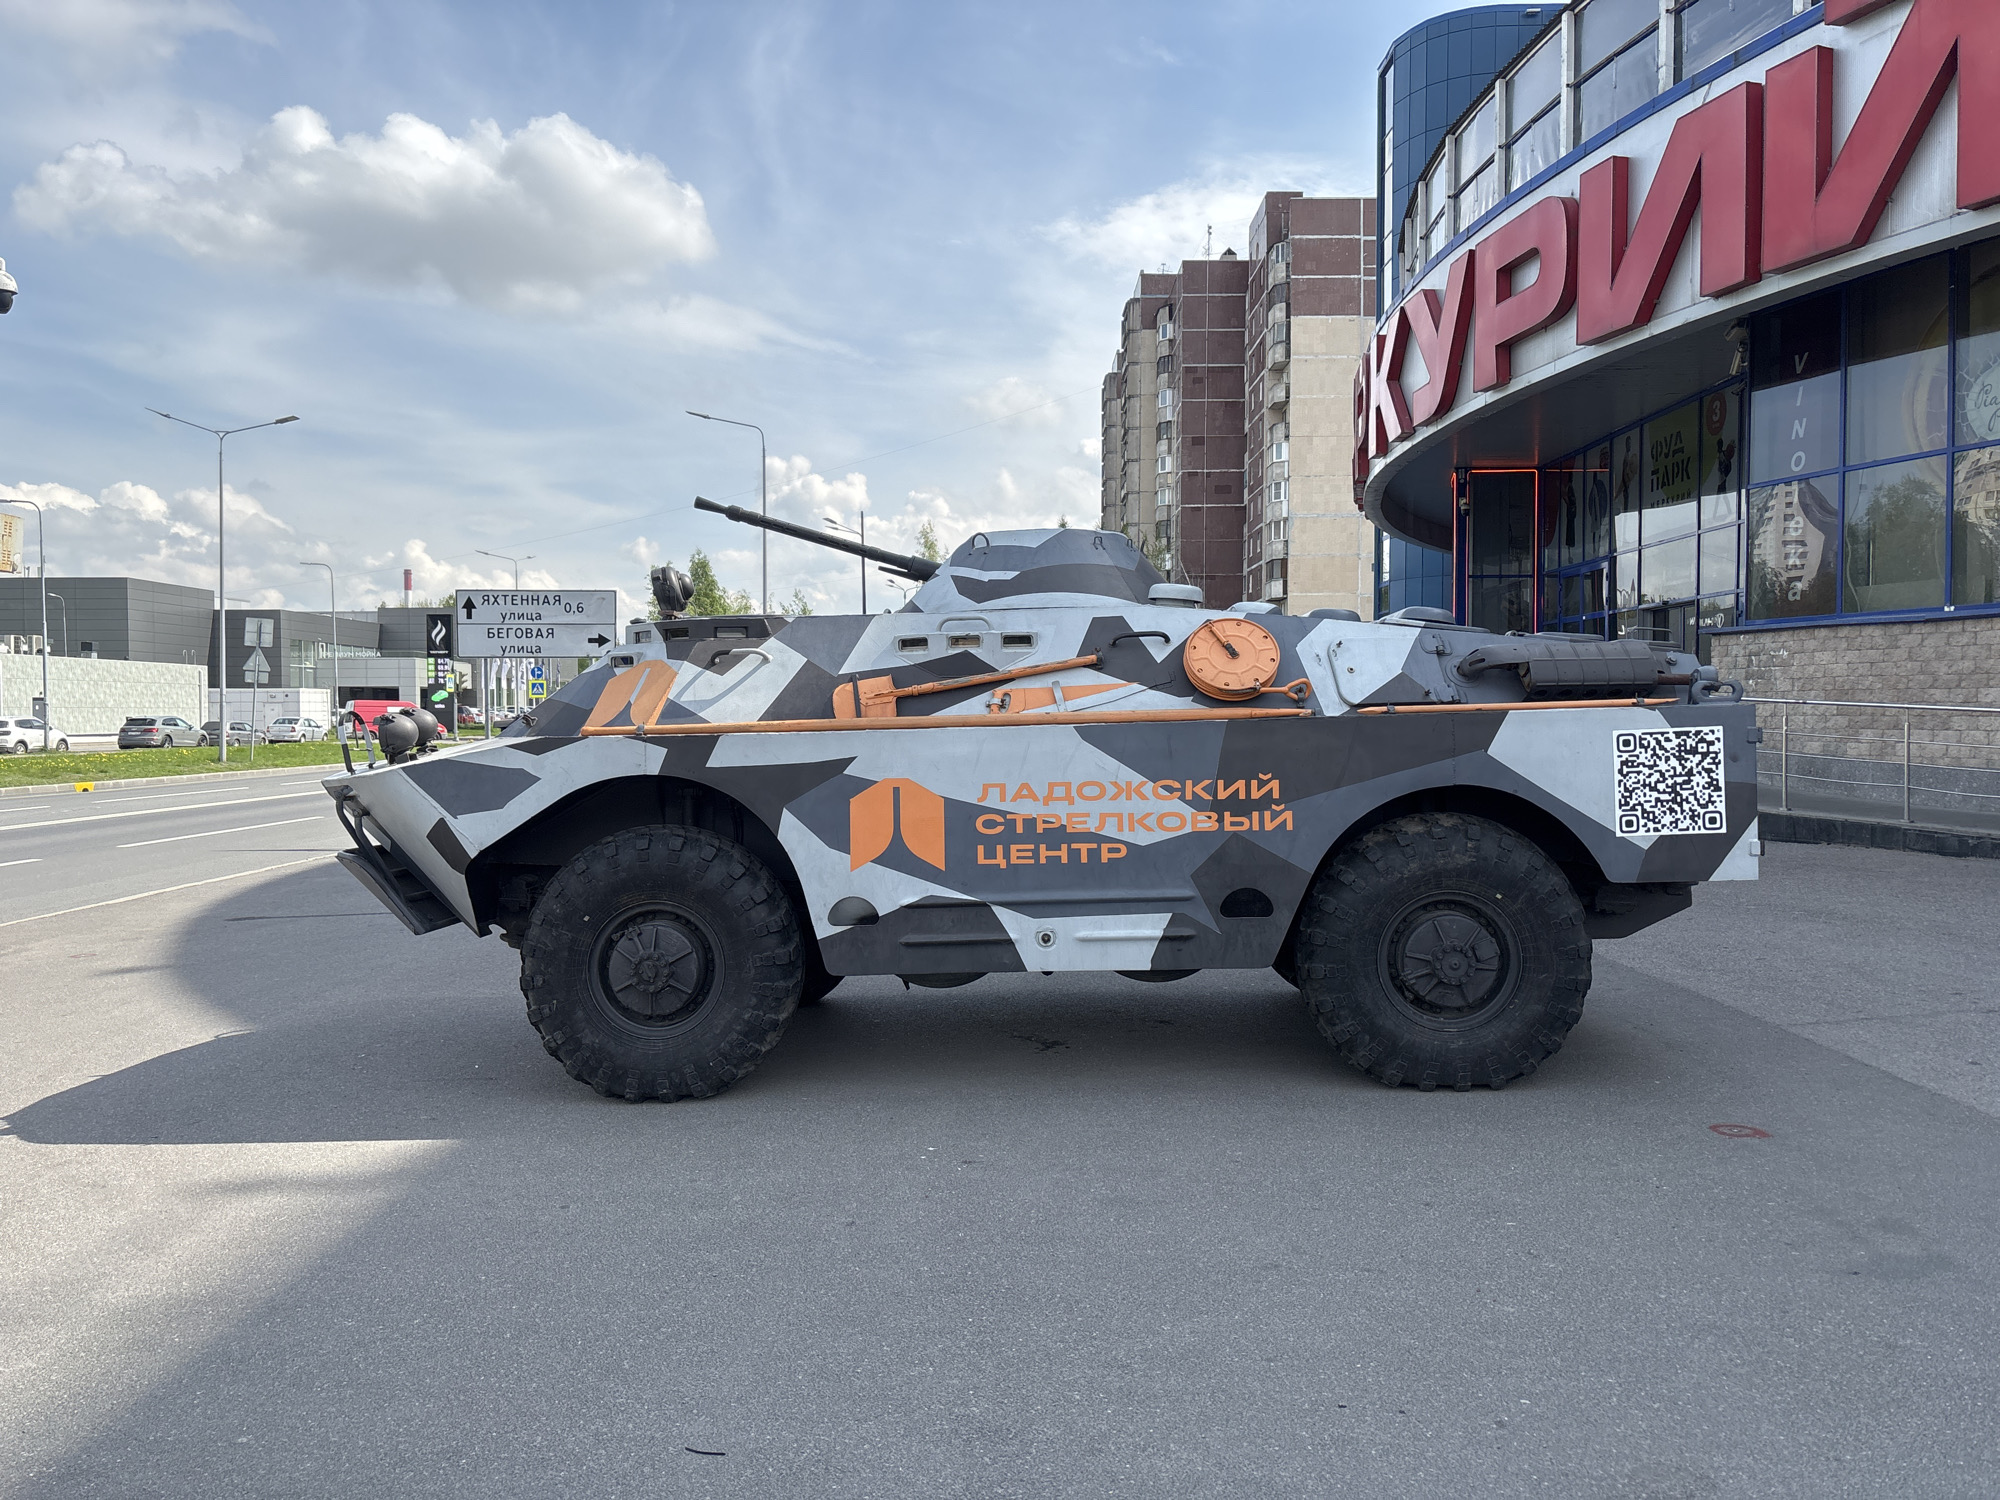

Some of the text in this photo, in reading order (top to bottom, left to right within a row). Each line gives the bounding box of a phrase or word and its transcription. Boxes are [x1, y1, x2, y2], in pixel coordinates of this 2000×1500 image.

[1352, 0, 2000, 511] РКУРИЙ
[1712, 400, 1721, 422] 3
[1651, 430, 1685, 462] ФУД
[1651, 456, 1691, 492] ПАРК
[481, 594, 584, 614] ЯХТЕННАЯ 0,6
[500, 612, 542, 623] улица
[487, 628, 555, 639] БЕГОВАЯ
[355, 650, 381, 658] МОЙКА
[500, 645, 542, 656] улица
[977, 772, 1280, 806] ЛАДОЖСКИЙ
[975, 803, 1294, 835] СТРЕЛКОВЫЙ
[977, 843, 1127, 869] ЦЕНТР
